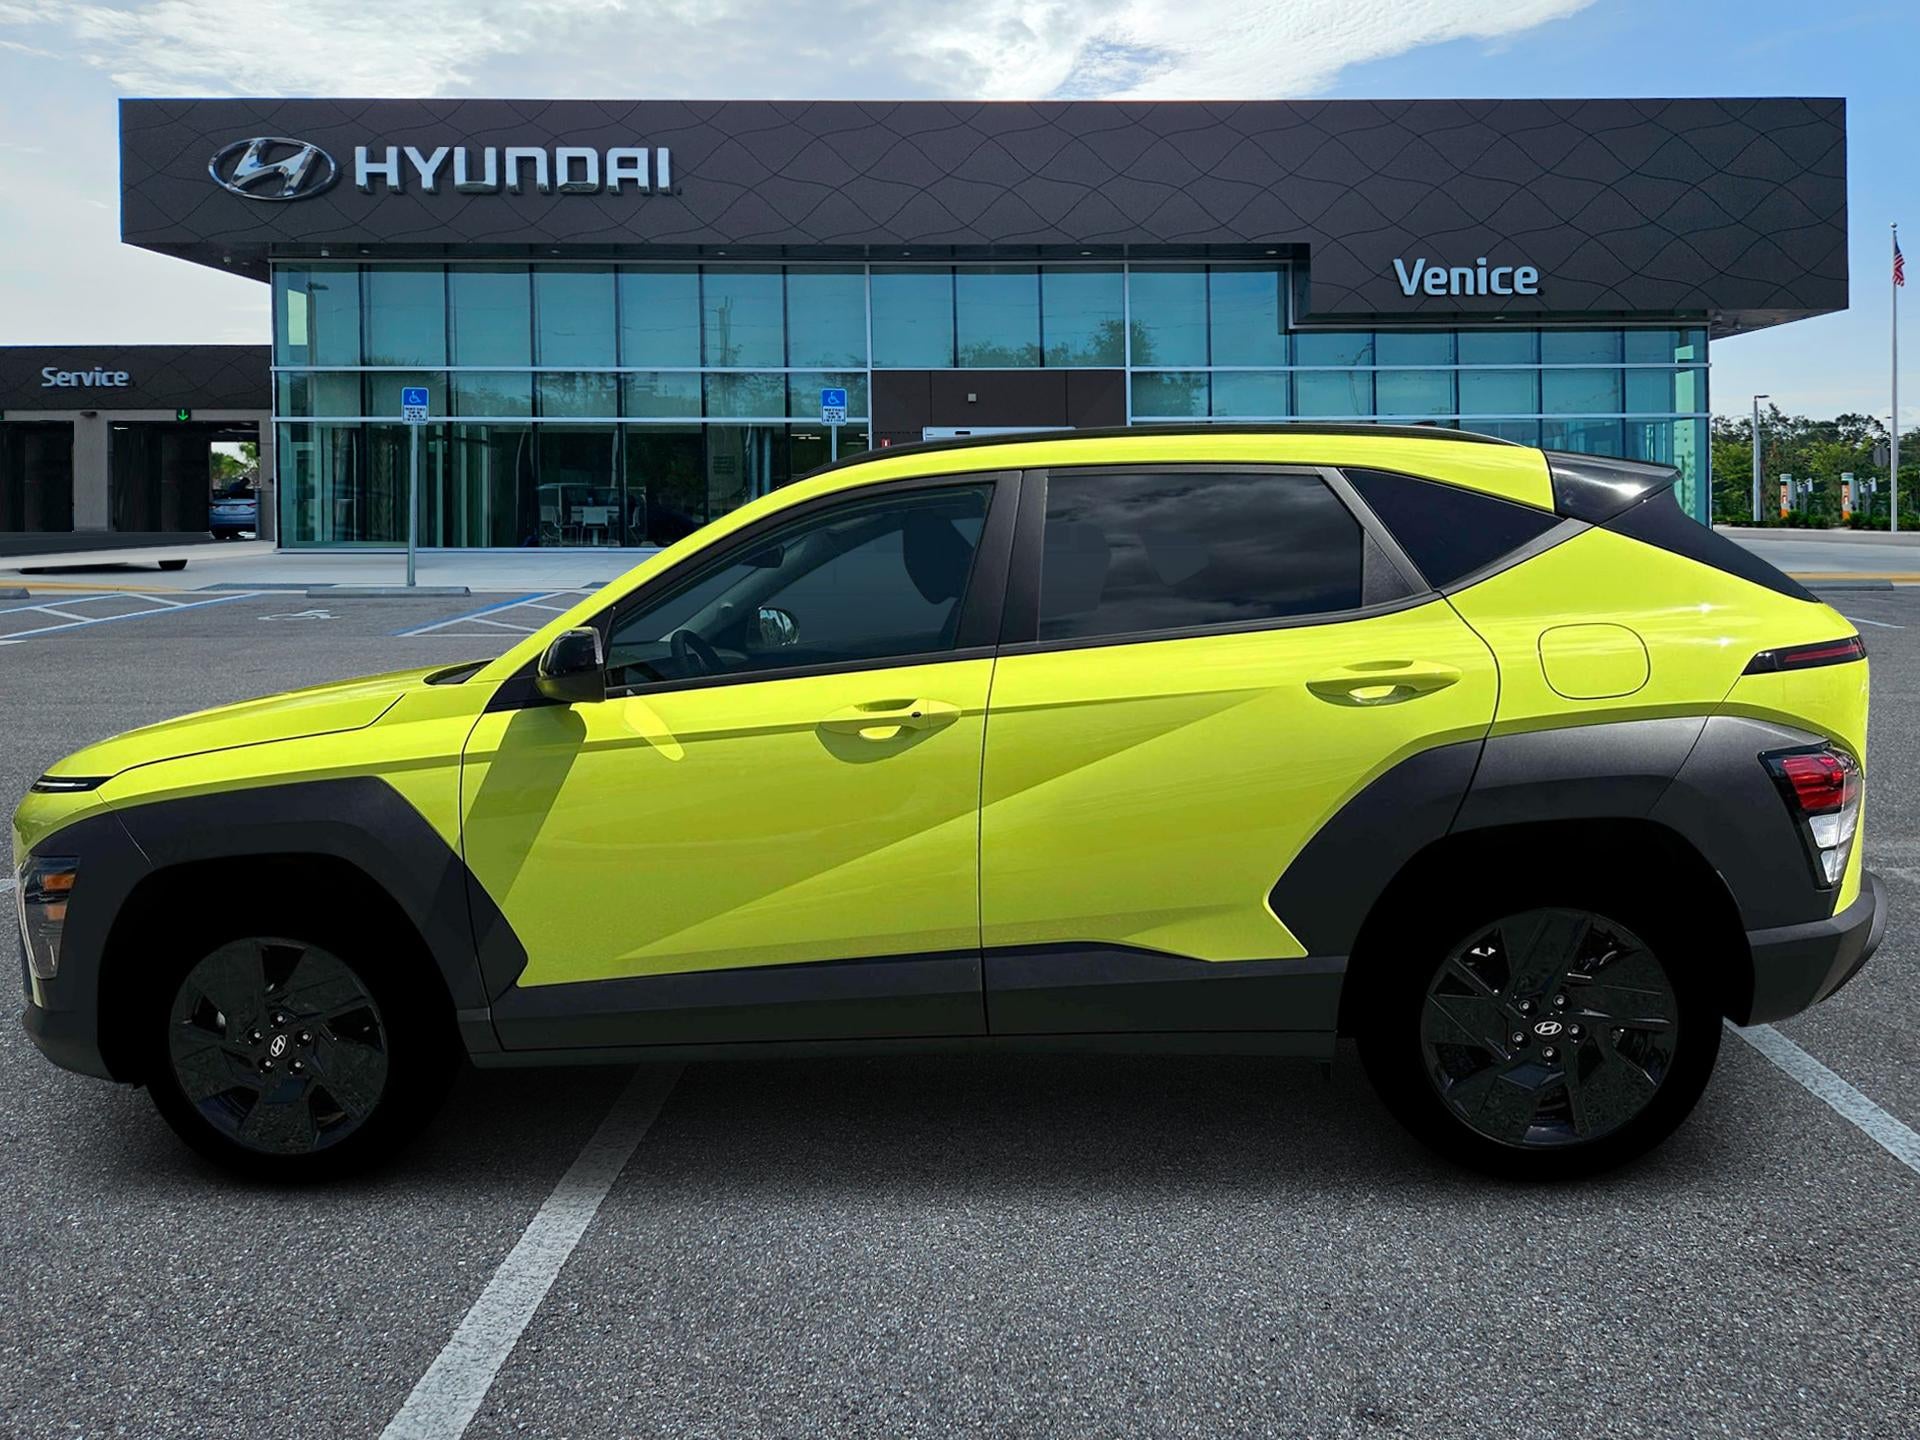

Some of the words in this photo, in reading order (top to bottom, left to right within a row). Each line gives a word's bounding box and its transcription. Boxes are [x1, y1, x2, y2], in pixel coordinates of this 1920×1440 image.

[354, 146, 671, 193] HYUNDAI
[1392, 256, 1539, 296] Venice
[41, 366, 130, 387] Service
